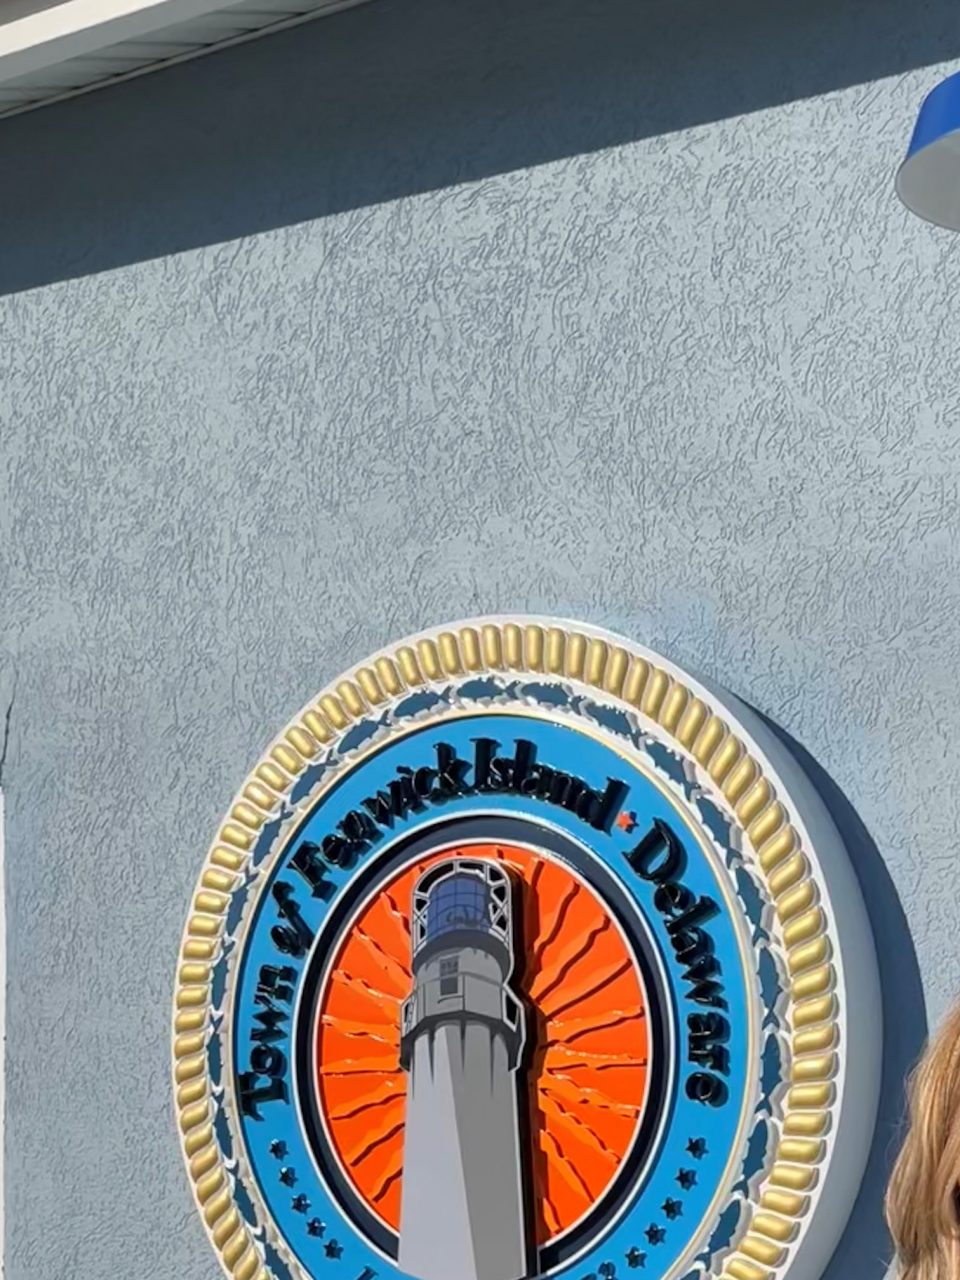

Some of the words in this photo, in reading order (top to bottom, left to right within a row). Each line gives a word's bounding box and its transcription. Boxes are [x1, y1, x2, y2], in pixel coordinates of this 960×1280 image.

[288, 741, 472, 902] Fenwick
[470, 737, 630, 837] Island
[270, 880, 317, 958] of
[621, 816, 731, 1108] Delaware
[240, 964, 298, 1121] Town
